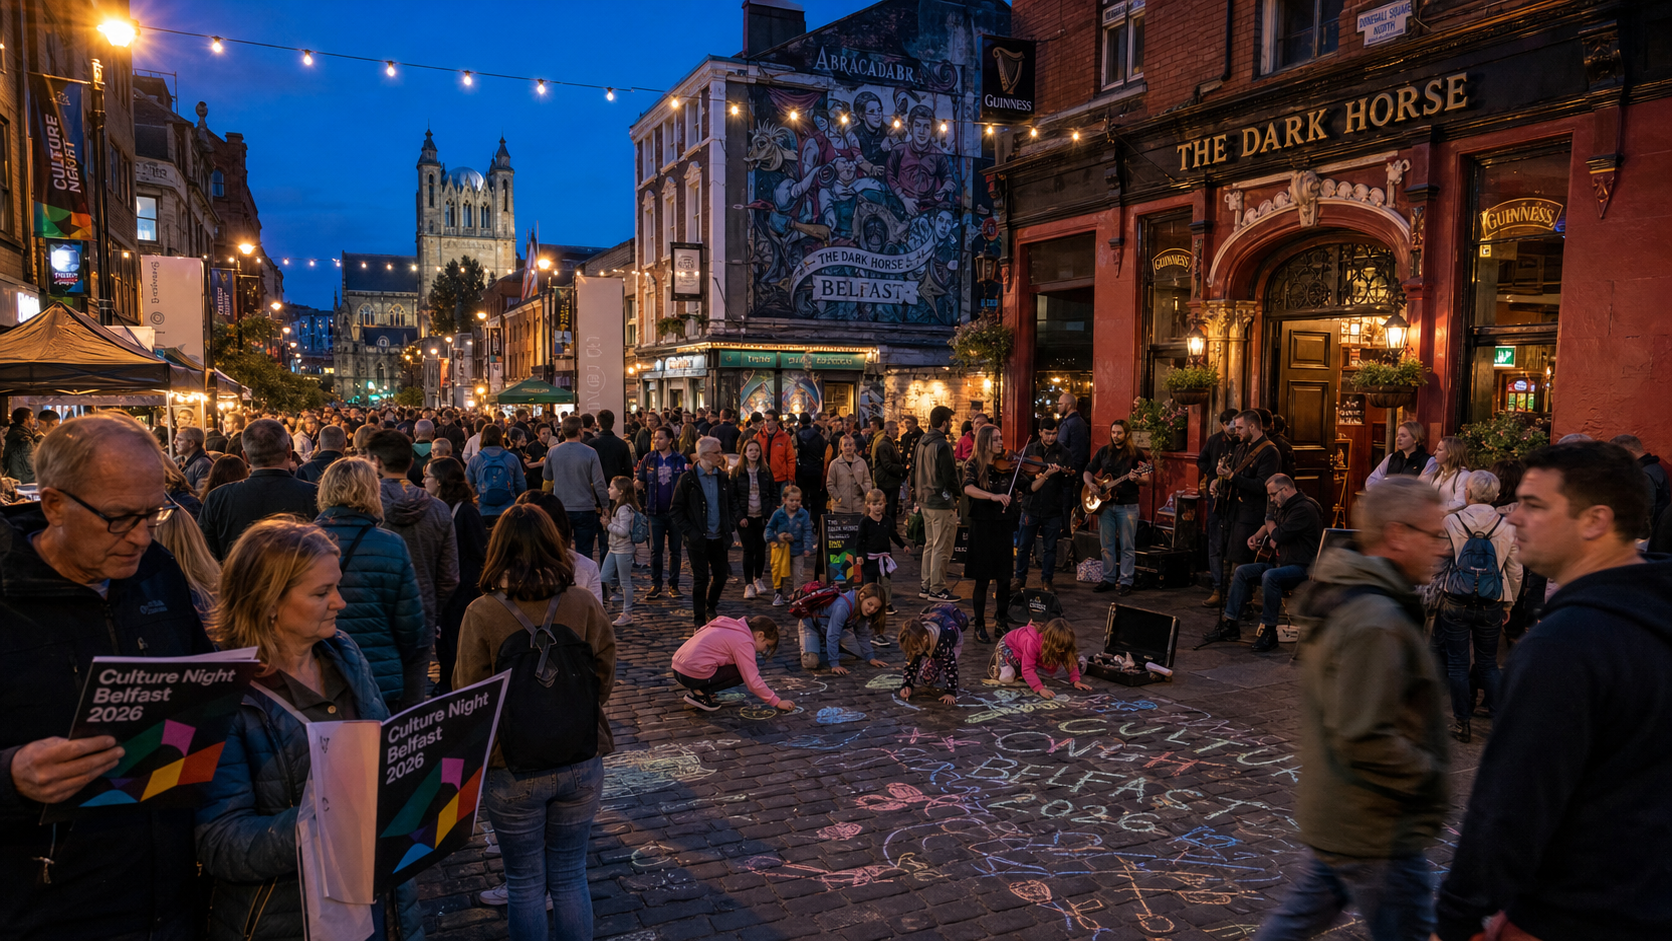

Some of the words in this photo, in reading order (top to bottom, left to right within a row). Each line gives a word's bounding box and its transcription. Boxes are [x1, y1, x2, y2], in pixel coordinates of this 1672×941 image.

[984, 93, 1032, 111] GUINNESS
[1176, 133, 1228, 172] THE
[1240, 108, 1330, 158] DARK
[1343, 72, 1469, 135] HORSE
[45, 113, 68, 192] CULTURE
[1487, 206, 1555, 229] GUINNESS
[818, 251, 839, 264] THE
[841, 251, 868, 265] DARK
[870, 257, 904, 270] HORSE
[821, 279, 904, 300] BELFAST
[98, 668, 180, 685] Culture
[181, 668, 237, 687] Night
[92, 687, 174, 704] Belfast
[86, 705, 145, 723] 2026
[387, 709, 446, 744] Culture
[448, 691, 490, 719] Night
[386, 725, 444, 765] Belfast
[385, 751, 425, 786] 2026
[965, 752, 1271, 820] BELFAST
[987, 792, 1161, 832] 2026
